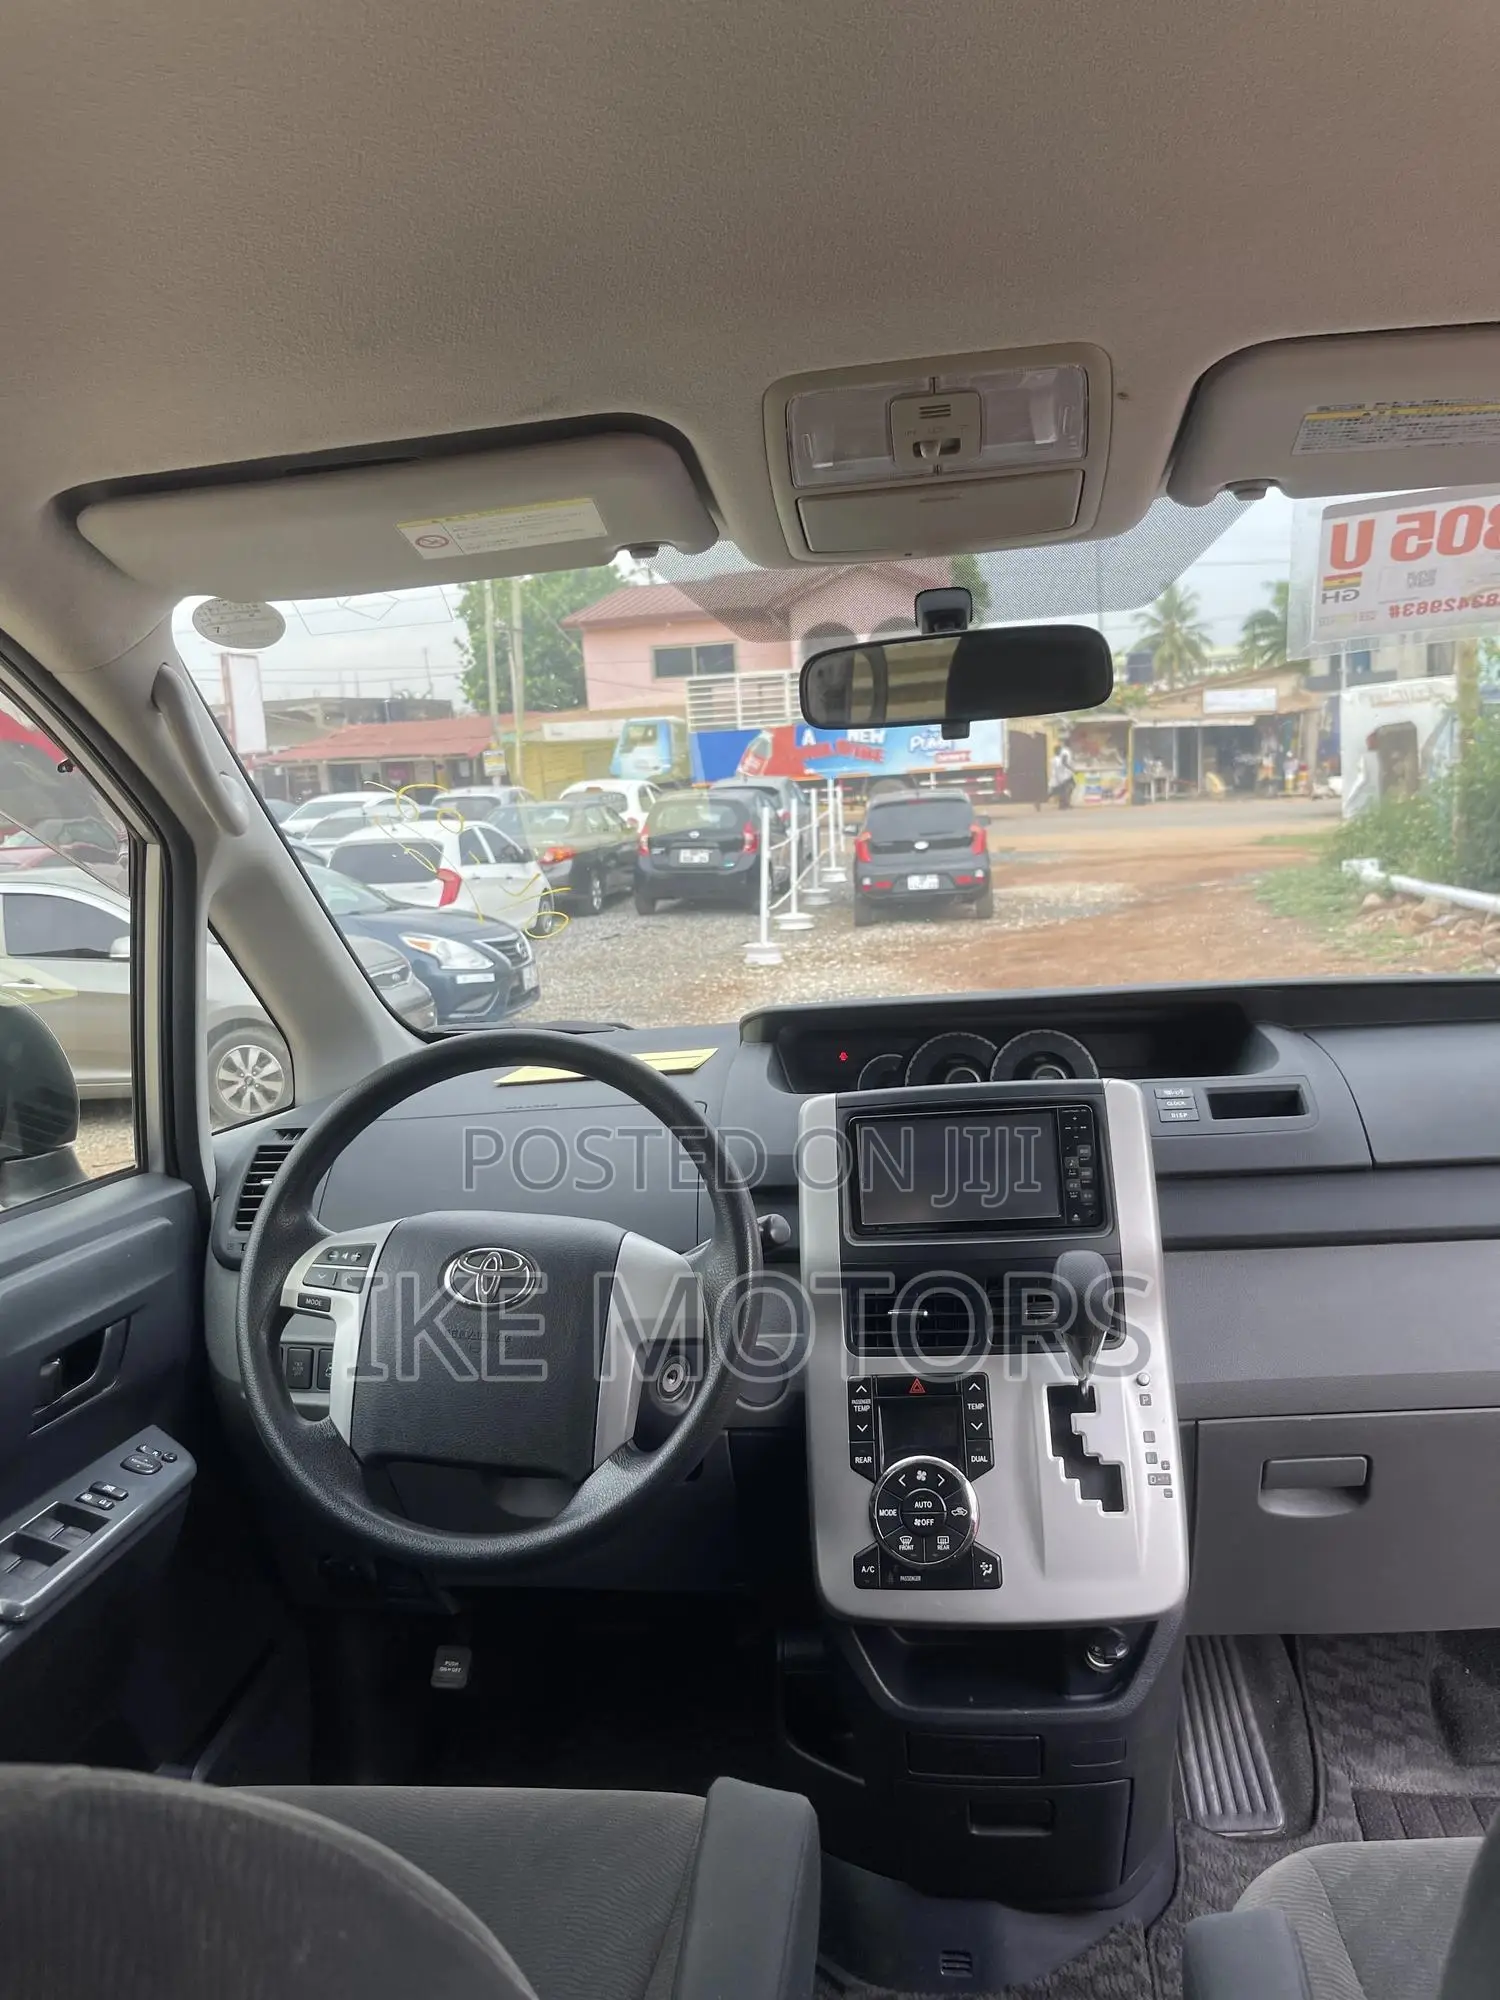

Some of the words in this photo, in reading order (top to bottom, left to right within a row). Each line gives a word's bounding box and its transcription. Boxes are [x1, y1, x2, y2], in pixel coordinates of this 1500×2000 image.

[854, 1456, 872, 1464] REAR
[921, 1518, 934, 1526] OFF
[861, 1565, 875, 1573] A/C
